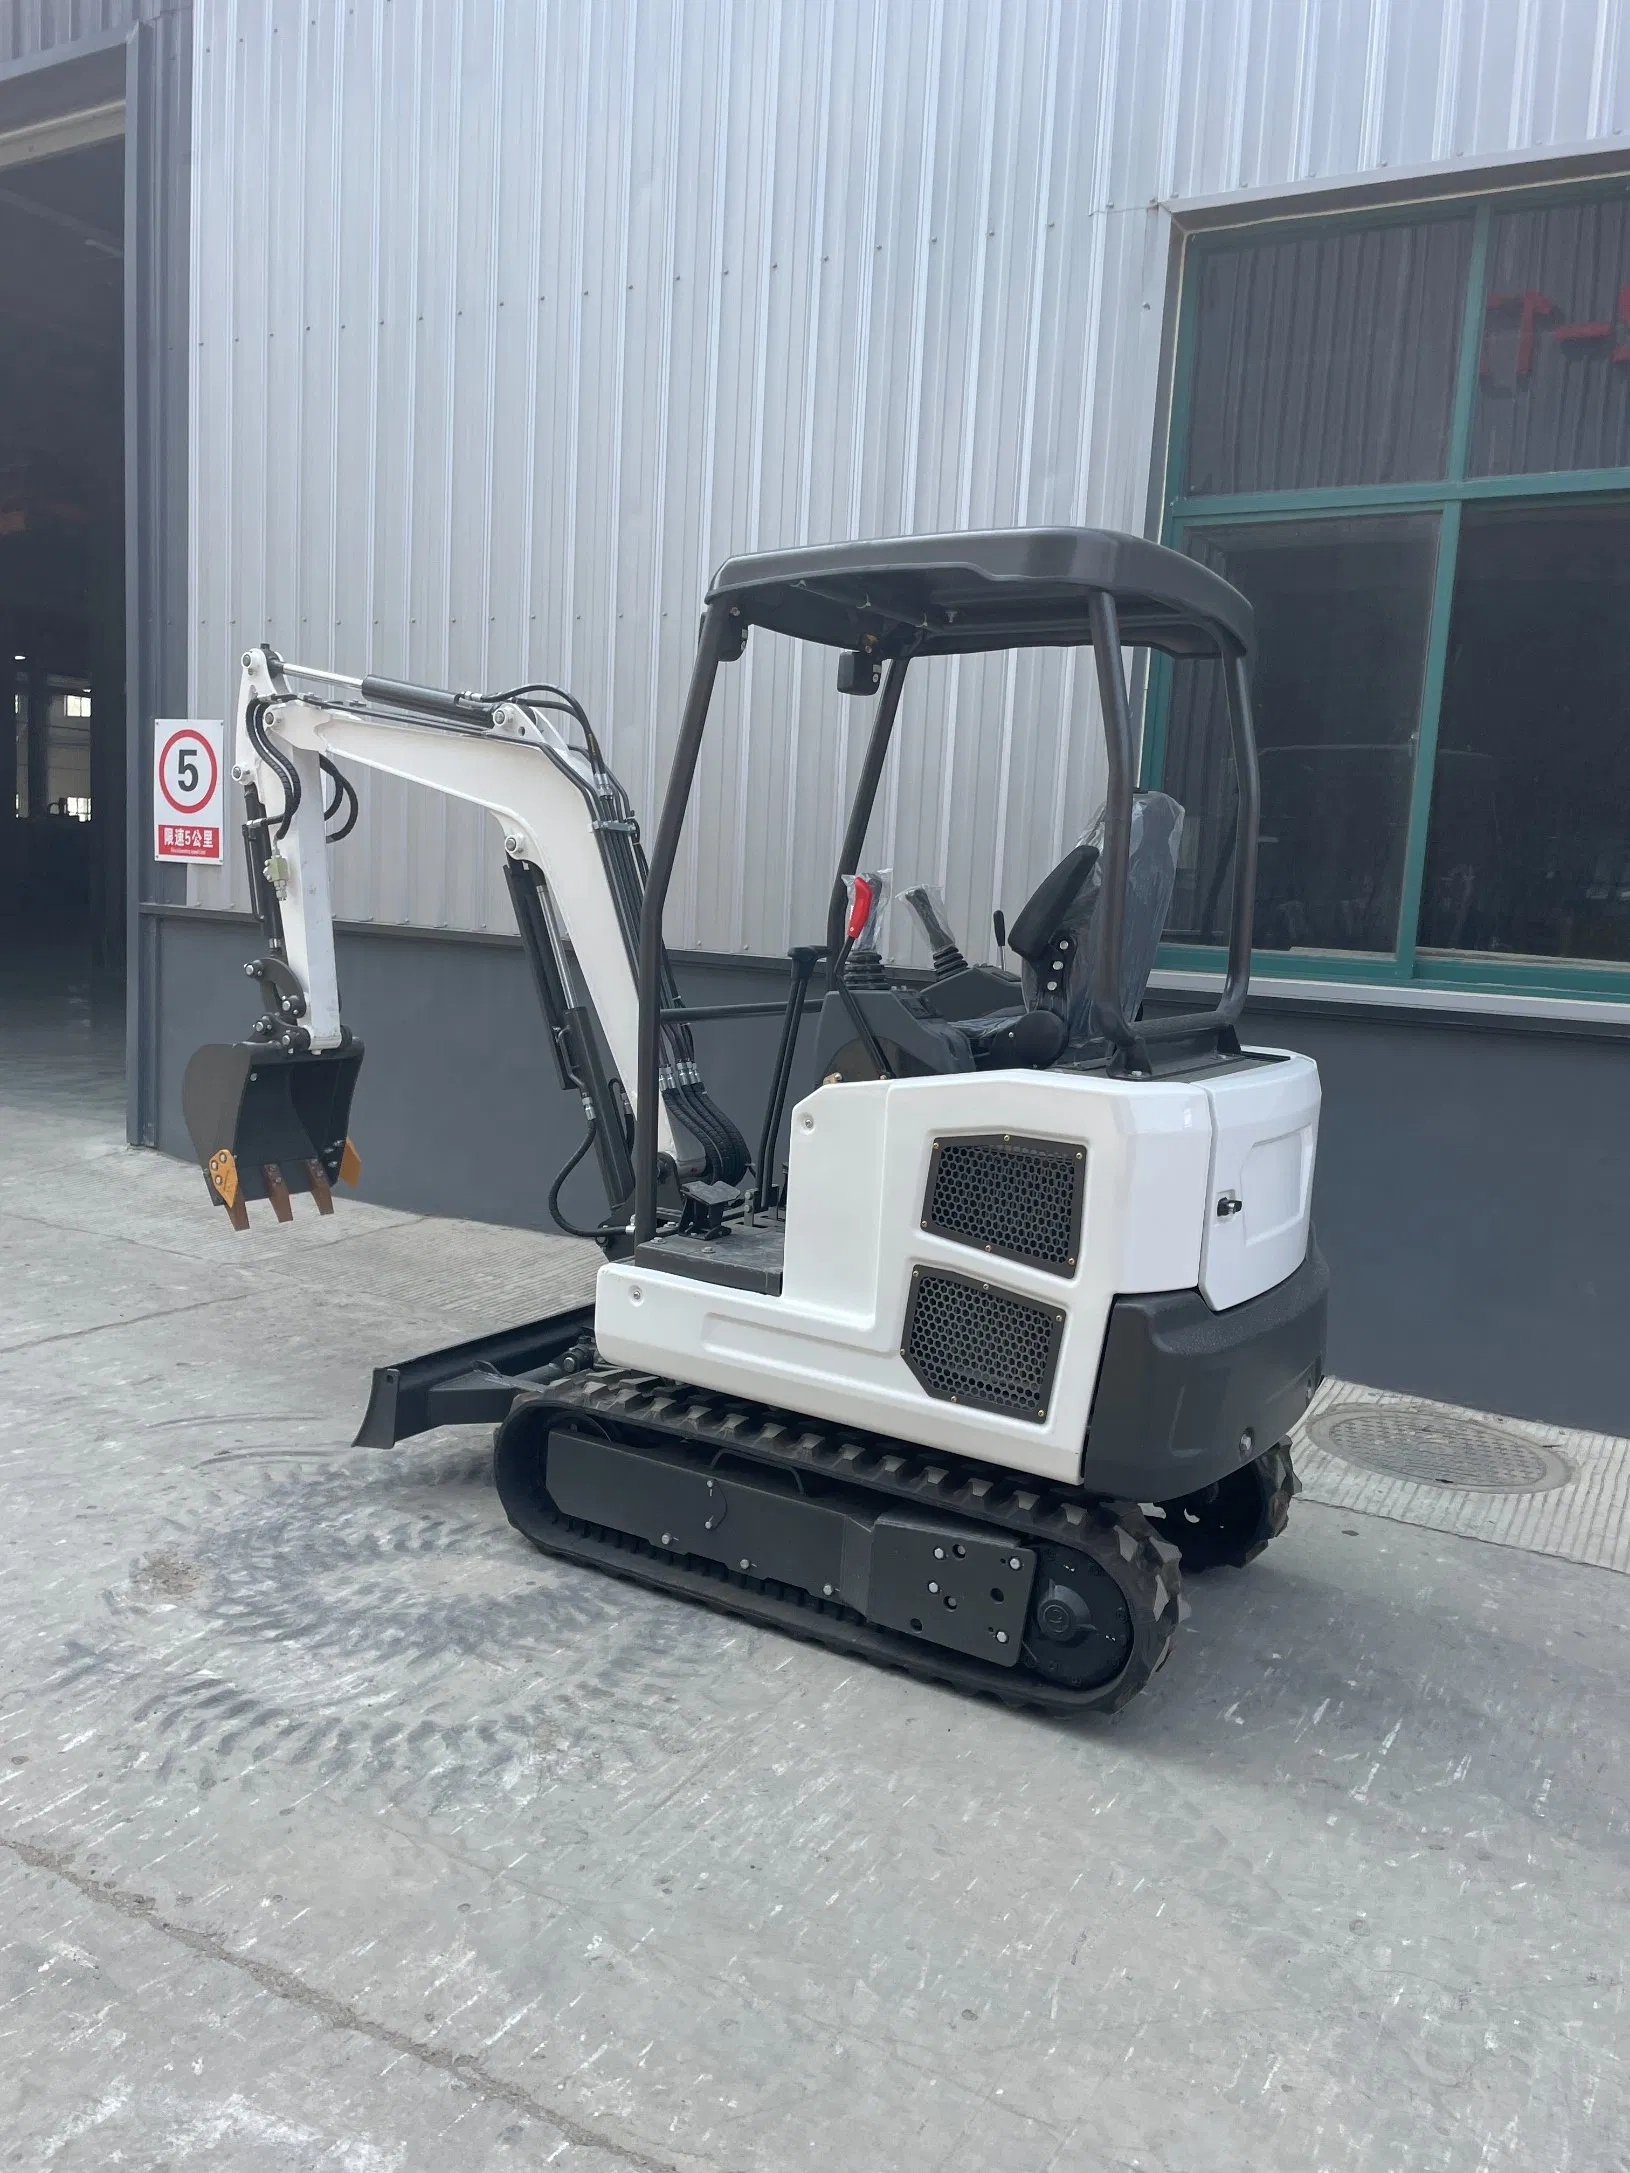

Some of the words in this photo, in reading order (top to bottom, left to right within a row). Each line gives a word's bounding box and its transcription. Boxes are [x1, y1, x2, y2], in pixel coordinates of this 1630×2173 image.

[177, 749, 199, 792] 5
[164, 827, 214, 848] 限速5公里
